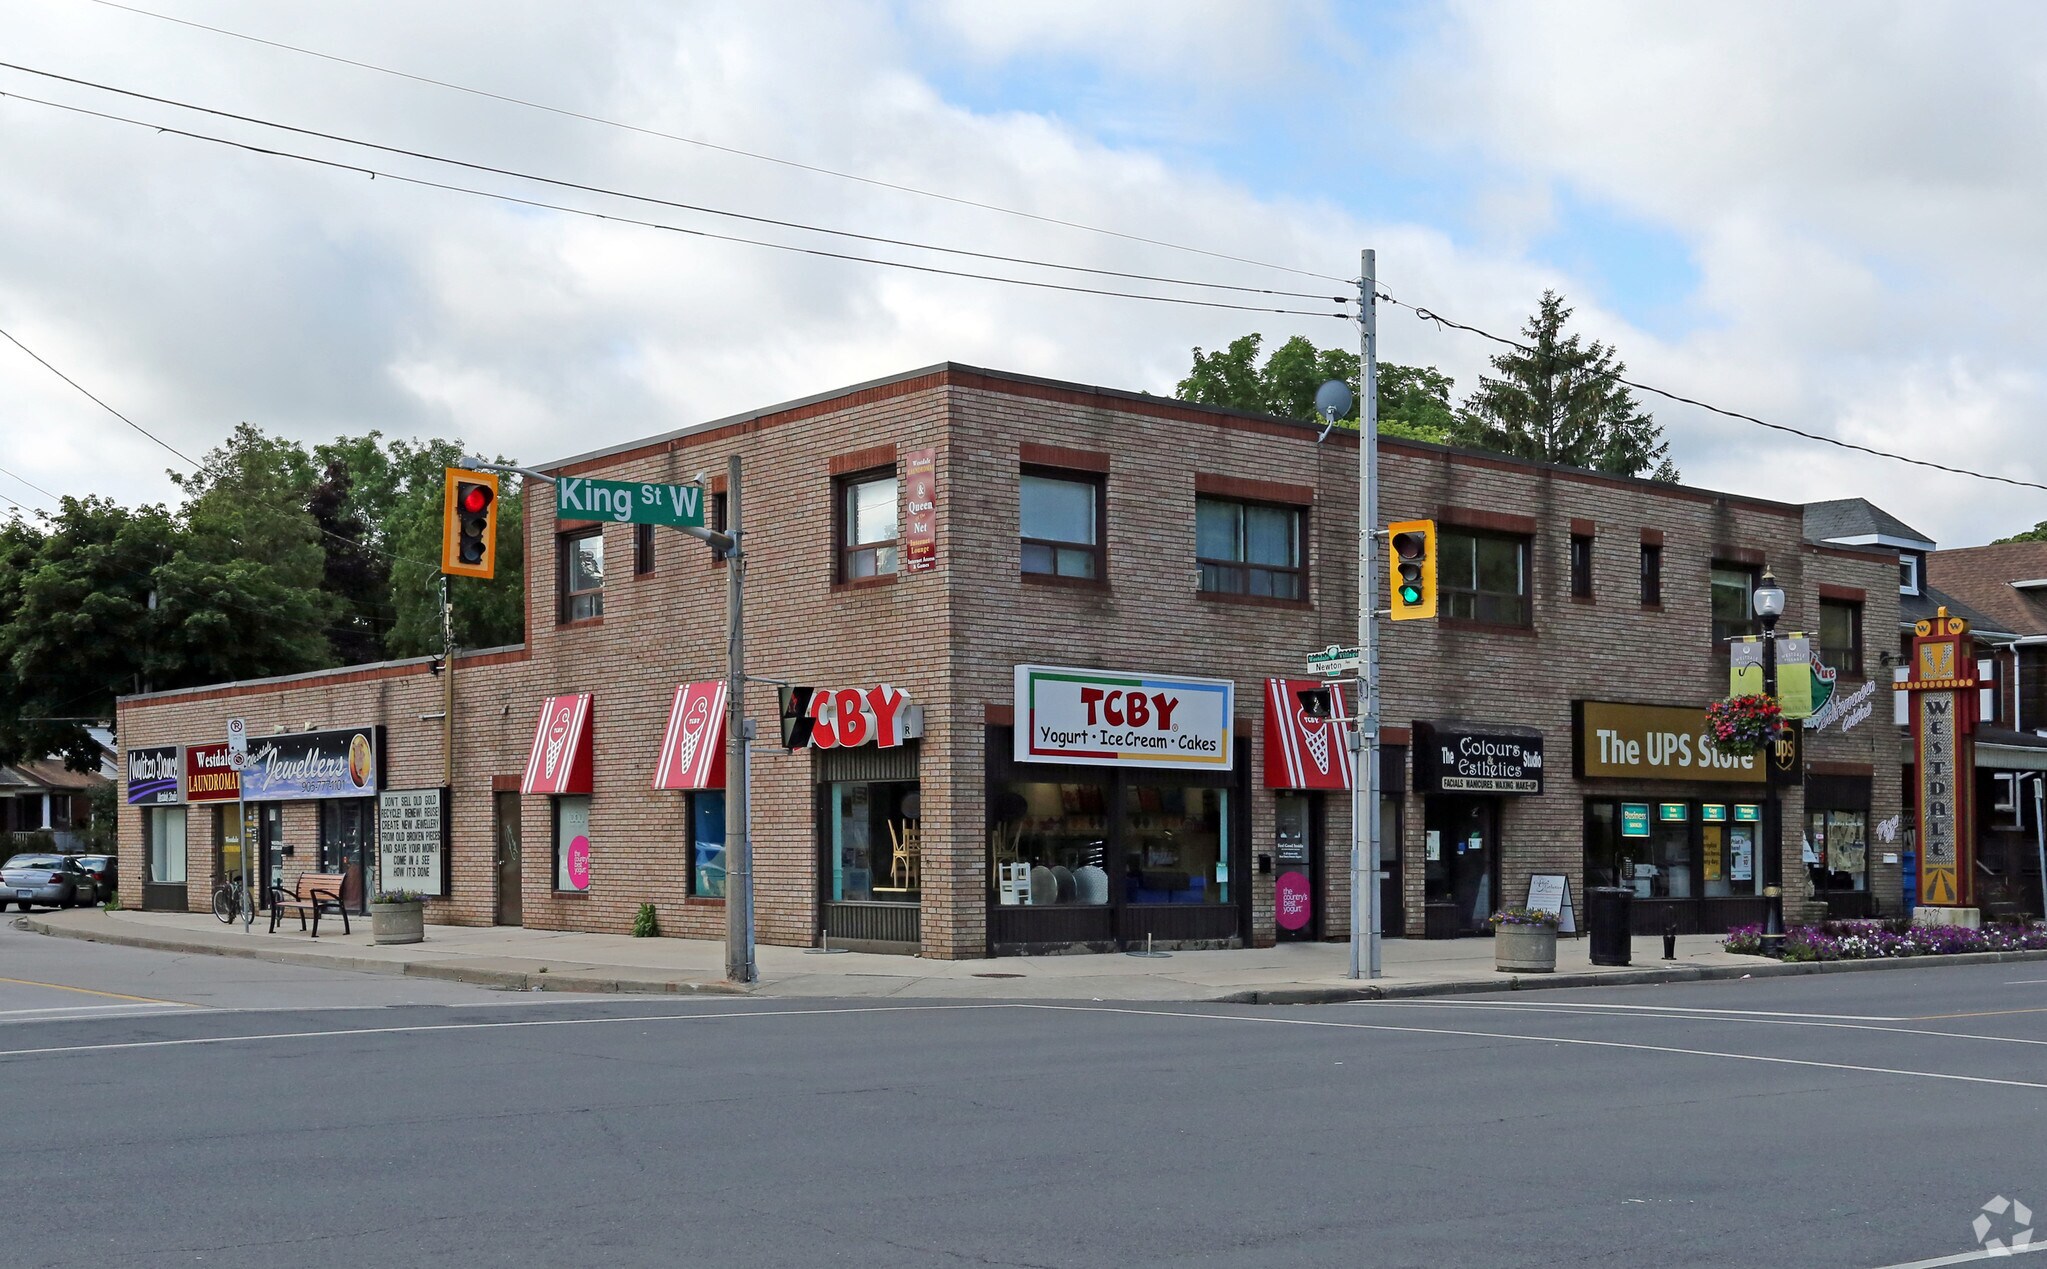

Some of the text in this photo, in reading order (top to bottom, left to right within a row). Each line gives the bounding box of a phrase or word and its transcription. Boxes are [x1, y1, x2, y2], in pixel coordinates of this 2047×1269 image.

[918, 484, 924, 495] &
[560, 478, 698, 521] King St W
[909, 501, 933, 515] Queen
[914, 522, 927, 533] Net
[910, 539, 930, 547] Internet
[911, 547, 930, 555] Lounge
[1316, 662, 1342, 672] Newton
[1081, 687, 1179, 731] TCBY
[811, 684, 903, 748] CBY
[1040, 727, 1088, 748] Yogurt
[1178, 735, 1216, 751] Cakes
[1460, 737, 1520, 757] Colours
[1597, 729, 1640, 764] The
[1647, 732, 1692, 767] UPS
[1775, 739, 1793, 764] ups
[1442, 747, 1455, 764] The
[1487, 756, 1493, 765] &
[1523, 750, 1541, 768] Studio
[263, 747, 346, 791] Jewellers
[1458, 759, 1522, 777] Esthetics
[1925, 700, 1950, 857] WESTDALE
[1444, 779, 1537, 790] FACIALS MANICURES WAXING MAKE-UP
[385, 795, 436, 806] DON'T SELL OLD GOLD
[1625, 811, 1647, 819] Business
[382, 819, 438, 829] CREATE NEW JEWELLERY
[382, 831, 440, 841] FROM OLD BROKEN PIECES
[383, 844, 392, 853] AND
[394, 844, 406, 853] SAVE
[409, 843, 420, 853] YOUR
[393, 856, 406, 865] COME
[421, 855, 430, 865] SEE
[394, 867, 404, 877] HOW
[417, 867, 429, 877] DONE
[1283, 887, 1292, 895] the
[1283, 893, 1308, 902] country's
[1283, 905, 1302, 914] yogurt
